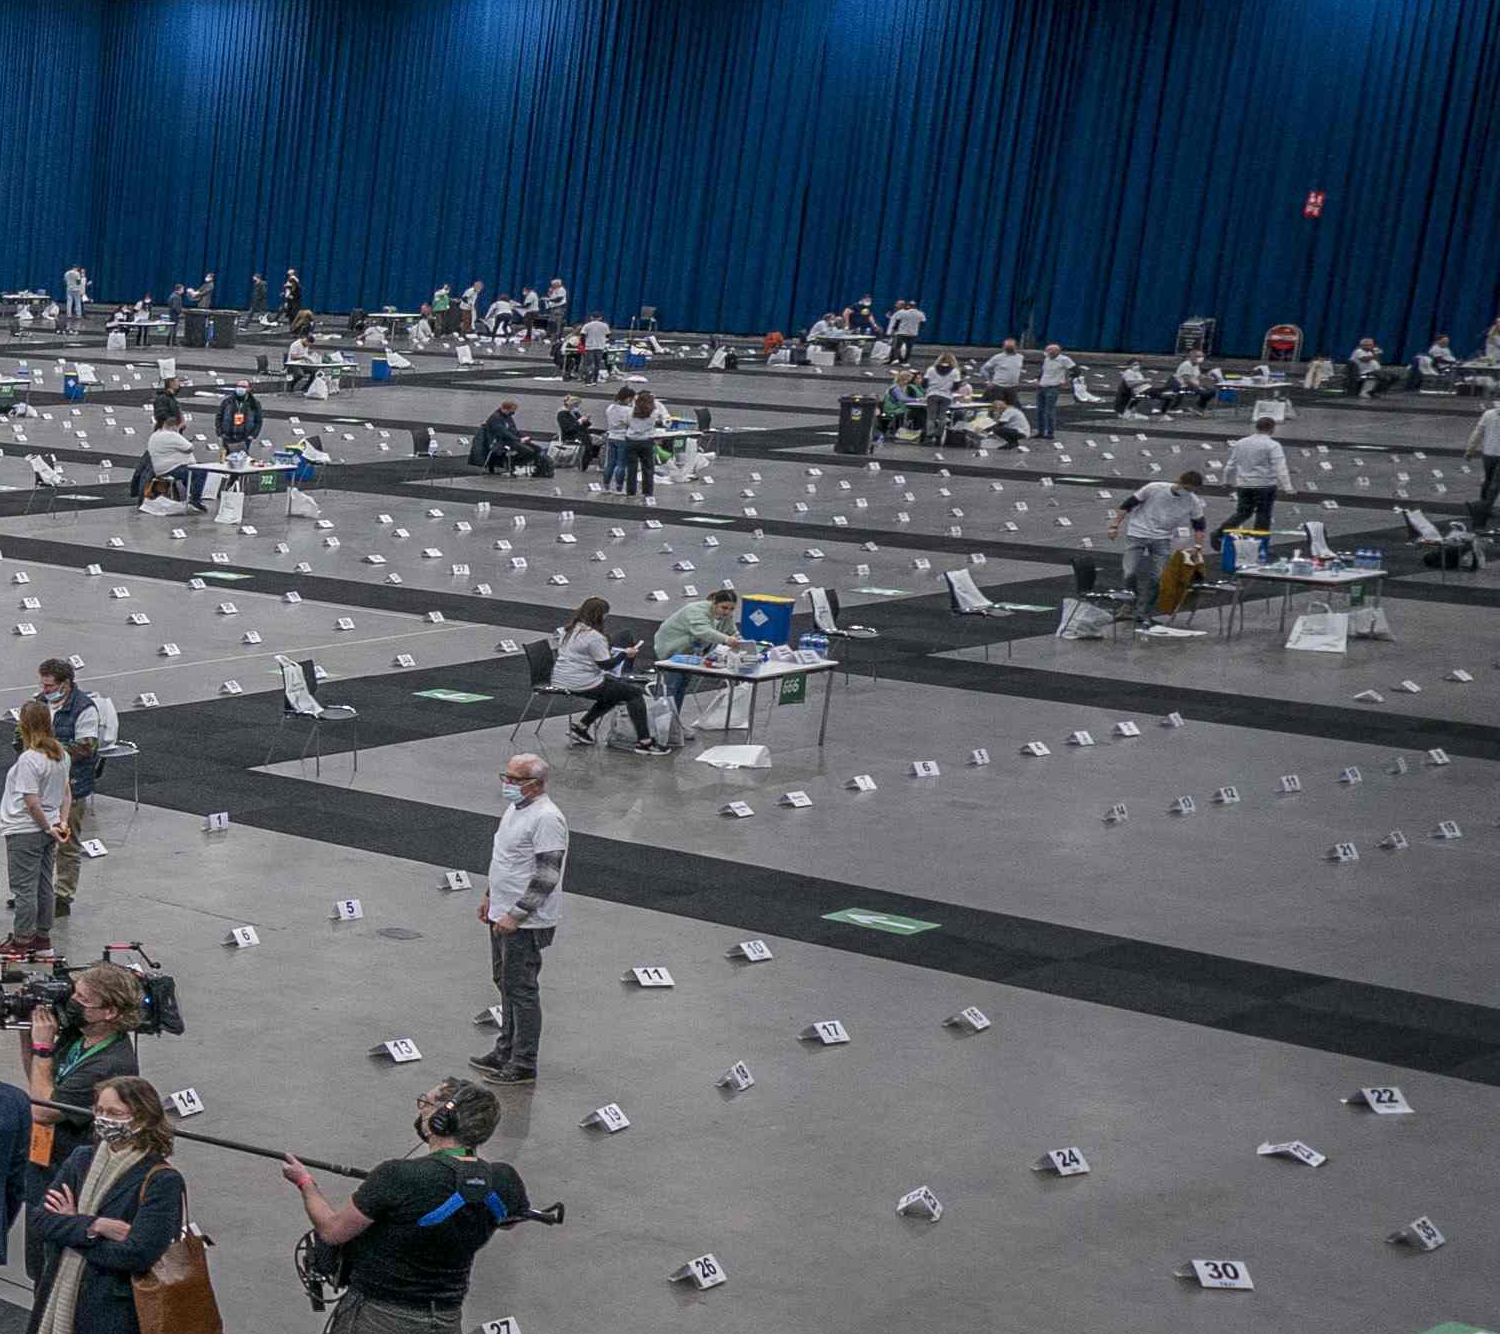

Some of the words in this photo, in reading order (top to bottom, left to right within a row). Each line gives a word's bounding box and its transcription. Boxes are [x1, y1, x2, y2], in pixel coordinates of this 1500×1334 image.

[217, 815, 221, 825] 1
[89, 842, 98, 850] 2
[1340, 845, 1352, 856] 21
[456, 873, 462, 883] 4
[346, 902, 354, 914] 5
[241, 929, 250, 940] 6
[748, 944, 763, 952] 10
[643, 969, 663, 979] 11
[822, 1024, 838, 1036] 17
[394, 1041, 412, 1053] 13
[179, 1091, 195, 1107] 14
[1371, 1089, 1398, 1103] 22
[604, 1107, 620, 1122] 19
[1055, 1147, 1080, 1167] 24
[695, 1258, 716, 1278] 26
[1205, 1262, 1239, 1280] 30
